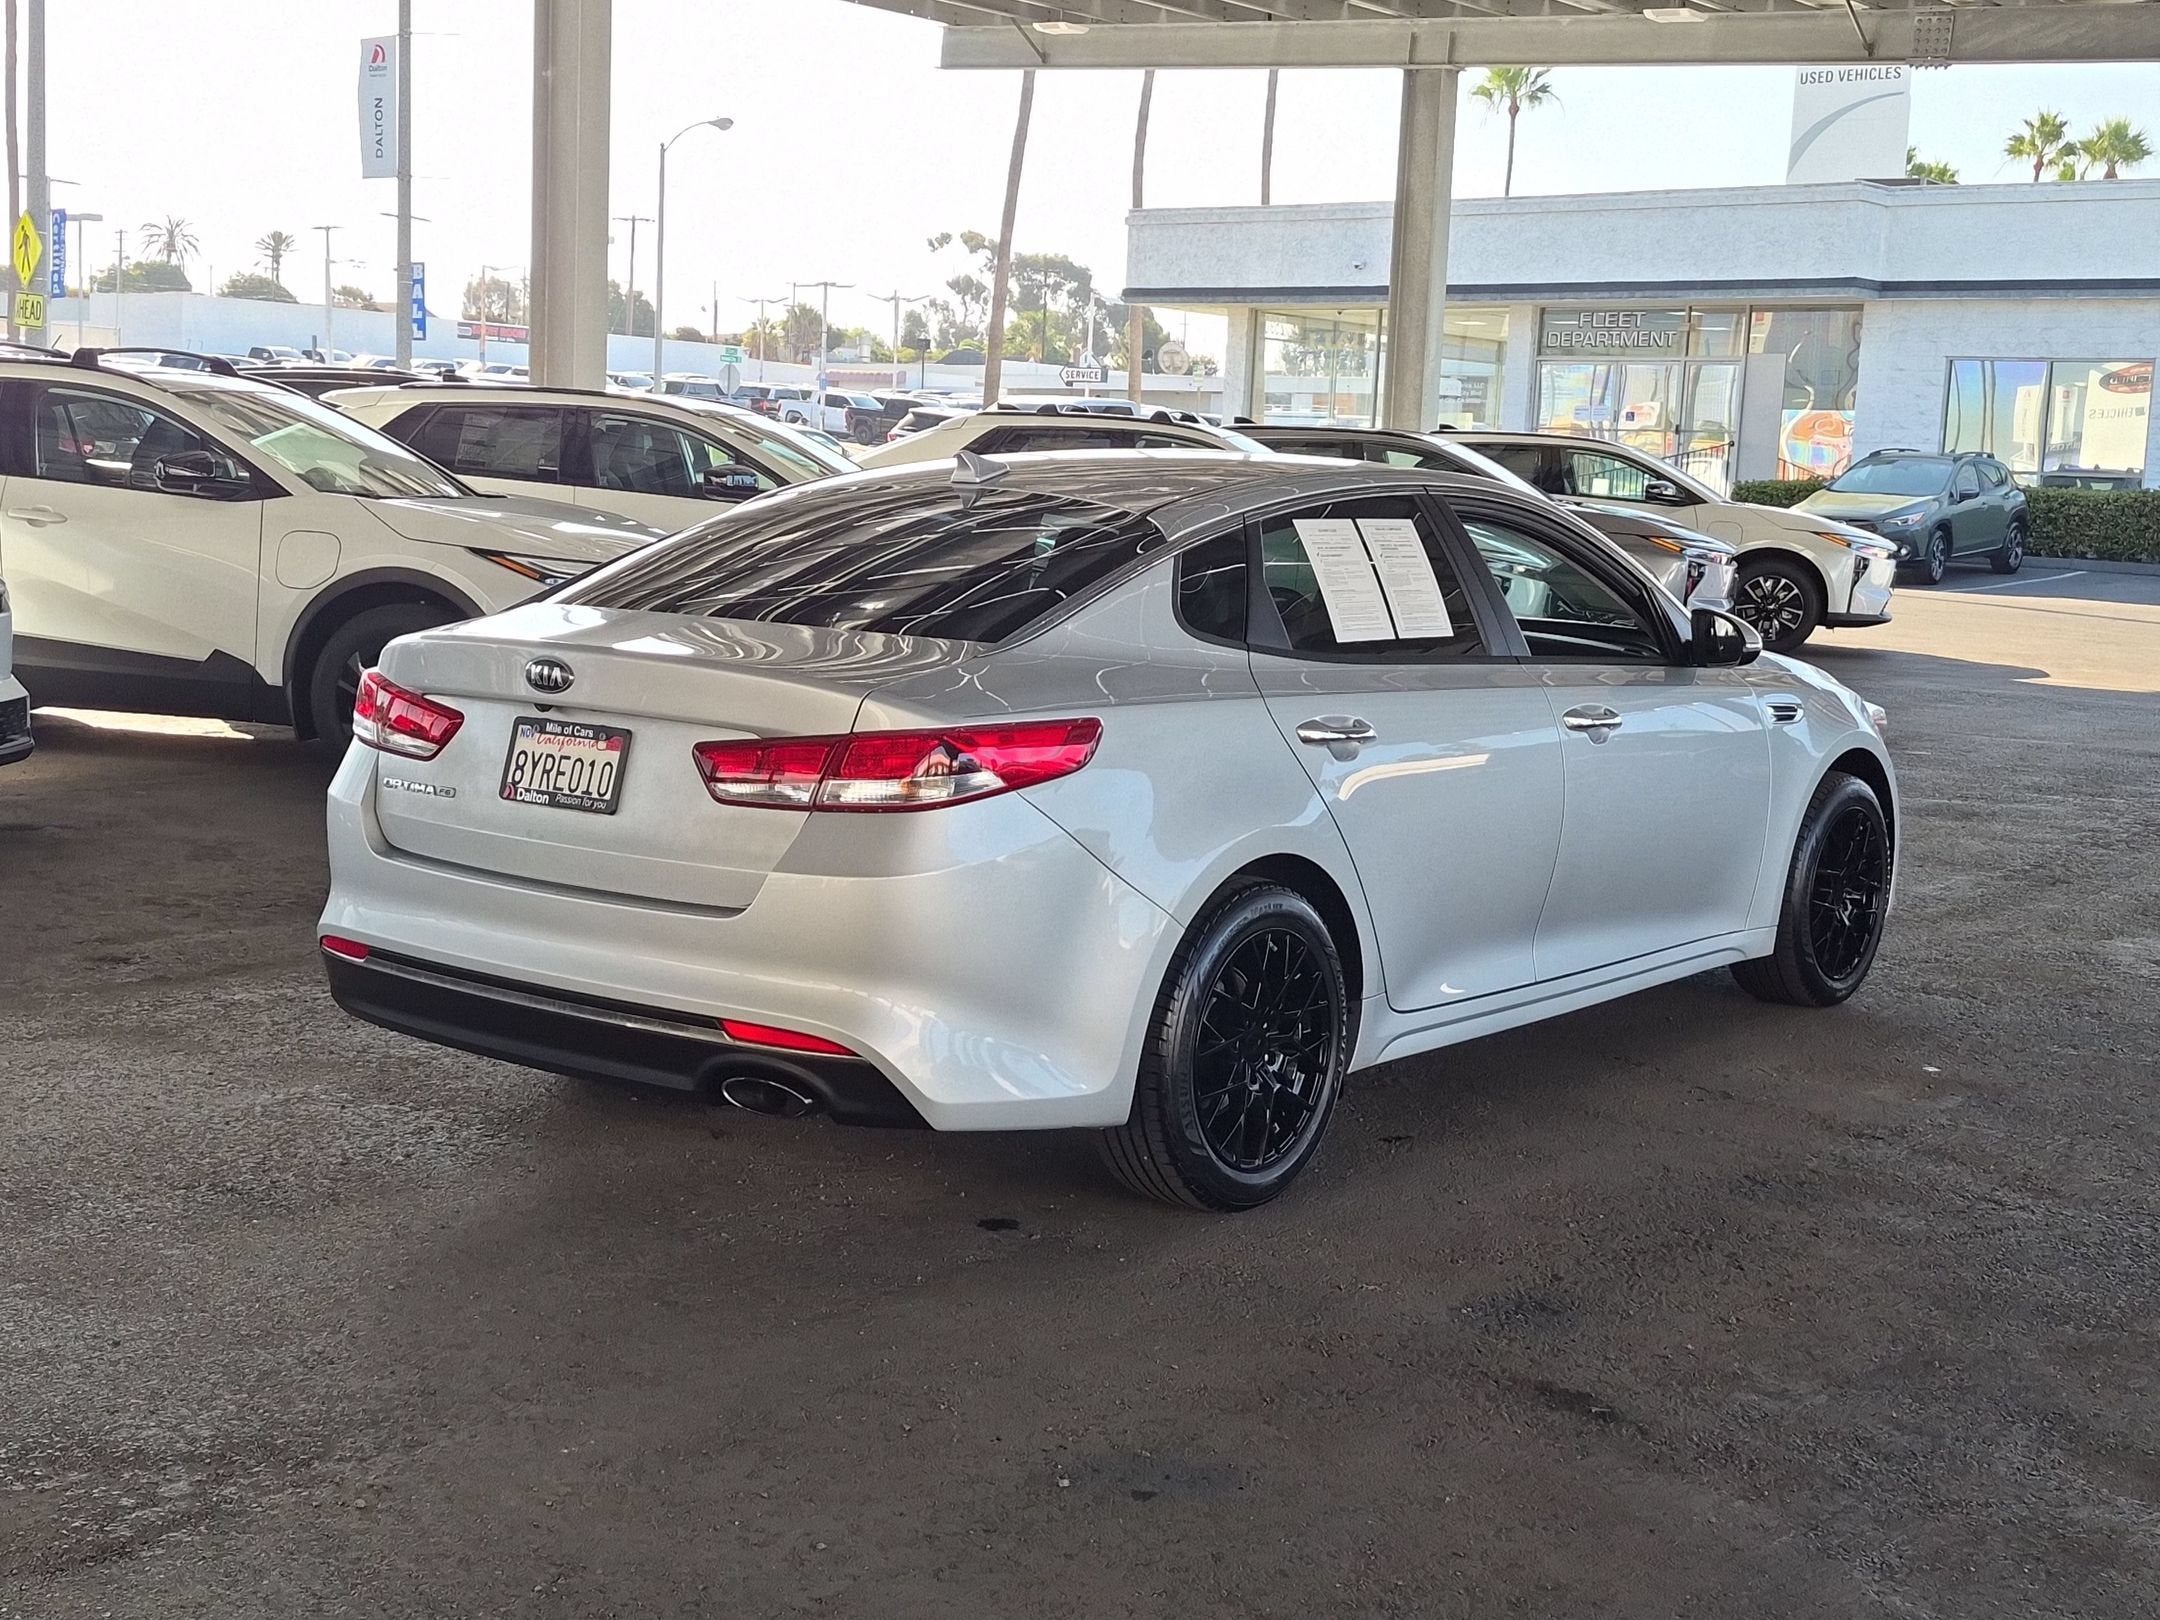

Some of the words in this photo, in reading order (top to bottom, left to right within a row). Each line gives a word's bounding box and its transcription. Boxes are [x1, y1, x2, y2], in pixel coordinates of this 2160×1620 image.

[1800, 70, 1834, 85] USED
[1838, 66, 1902, 82] VEHICLES
[374, 97, 384, 159] DALTON
[1579, 311, 1647, 328] FLEET
[1546, 331, 1678, 347] DEPARTMENT
[1065, 370, 1100, 380] SERVICE
[530, 664, 563, 687] KIA
[545, 721, 562, 734] Mile
[563, 725, 573, 736] of
[573, 726, 594, 738] Cars
[536, 732, 599, 752] California
[512, 750, 614, 798] 8YRE010
[516, 788, 549, 805] Dalton
[555, 794, 582, 806] Passion
[582, 797, 593, 807] for
[592, 799, 607, 810] you
